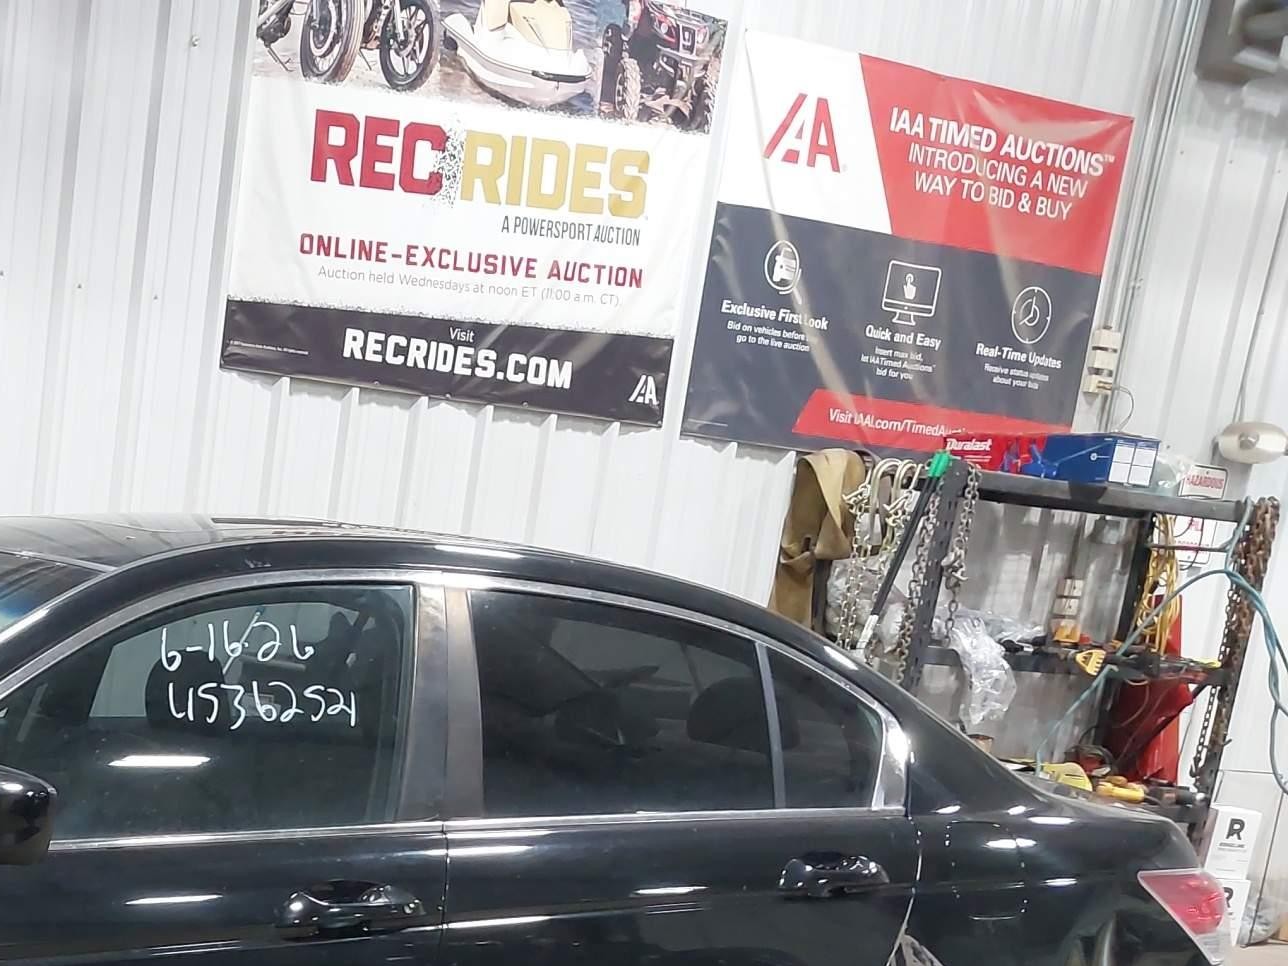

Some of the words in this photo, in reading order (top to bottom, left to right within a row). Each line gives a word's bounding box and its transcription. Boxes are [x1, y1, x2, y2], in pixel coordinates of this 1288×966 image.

[890, 107, 924, 139] IAA
[928, 117, 997, 152] TIMED
[311, 109, 450, 196] REC
[461, 129, 650, 220] RIDES
[908, 143, 1027, 187] INTRODUCING
[1030, 170, 1043, 188] A
[1047, 173, 1088, 198] NEW
[915, 171, 957, 196] WAY
[961, 179, 985, 202] TO
[989, 186, 1015, 209] BID
[1018, 192, 1032, 213] &
[1036, 195, 1073, 221] BUY
[501, 215, 510, 233] A
[513, 216, 592, 241] POWERSPORT
[593, 224, 641, 246] AUCTION
[300, 233, 538, 279] ONLINE-EXCLUSIVE
[547, 260, 643, 289] AUCTION
[318, 265, 365, 281] Auction
[369, 271, 395, 284] held
[398, 273, 470, 293] Wednesdays
[473, 283, 484, 294] at
[489, 285, 518, 297] noon
[522, 286, 537, 298] ET
[721, 299, 777, 320] Exclusive
[778, 308, 803, 324] First
[449, 326, 475, 342] Visit
[727, 320, 741, 331] Bid
[742, 325, 752, 333] on
[754, 326, 781, 337] vehicles
[783, 329, 805, 341] before
[736, 334, 747, 343] go
[748, 335, 757, 343] to
[758, 337, 769, 346] the
[770, 338, 783, 348] live
[784, 341, 810, 352] auction
[865, 324, 892, 341] Quick
[894, 332, 914, 344] and
[916, 333, 942, 351] Easy
[342, 328, 573, 389] RECRIDES.COM
[976, 343, 1027, 362] Real-Time
[1028, 352, 1062, 369] Updates
[829, 408, 854, 424] Visit
[945, 438, 993, 451] Duralast
